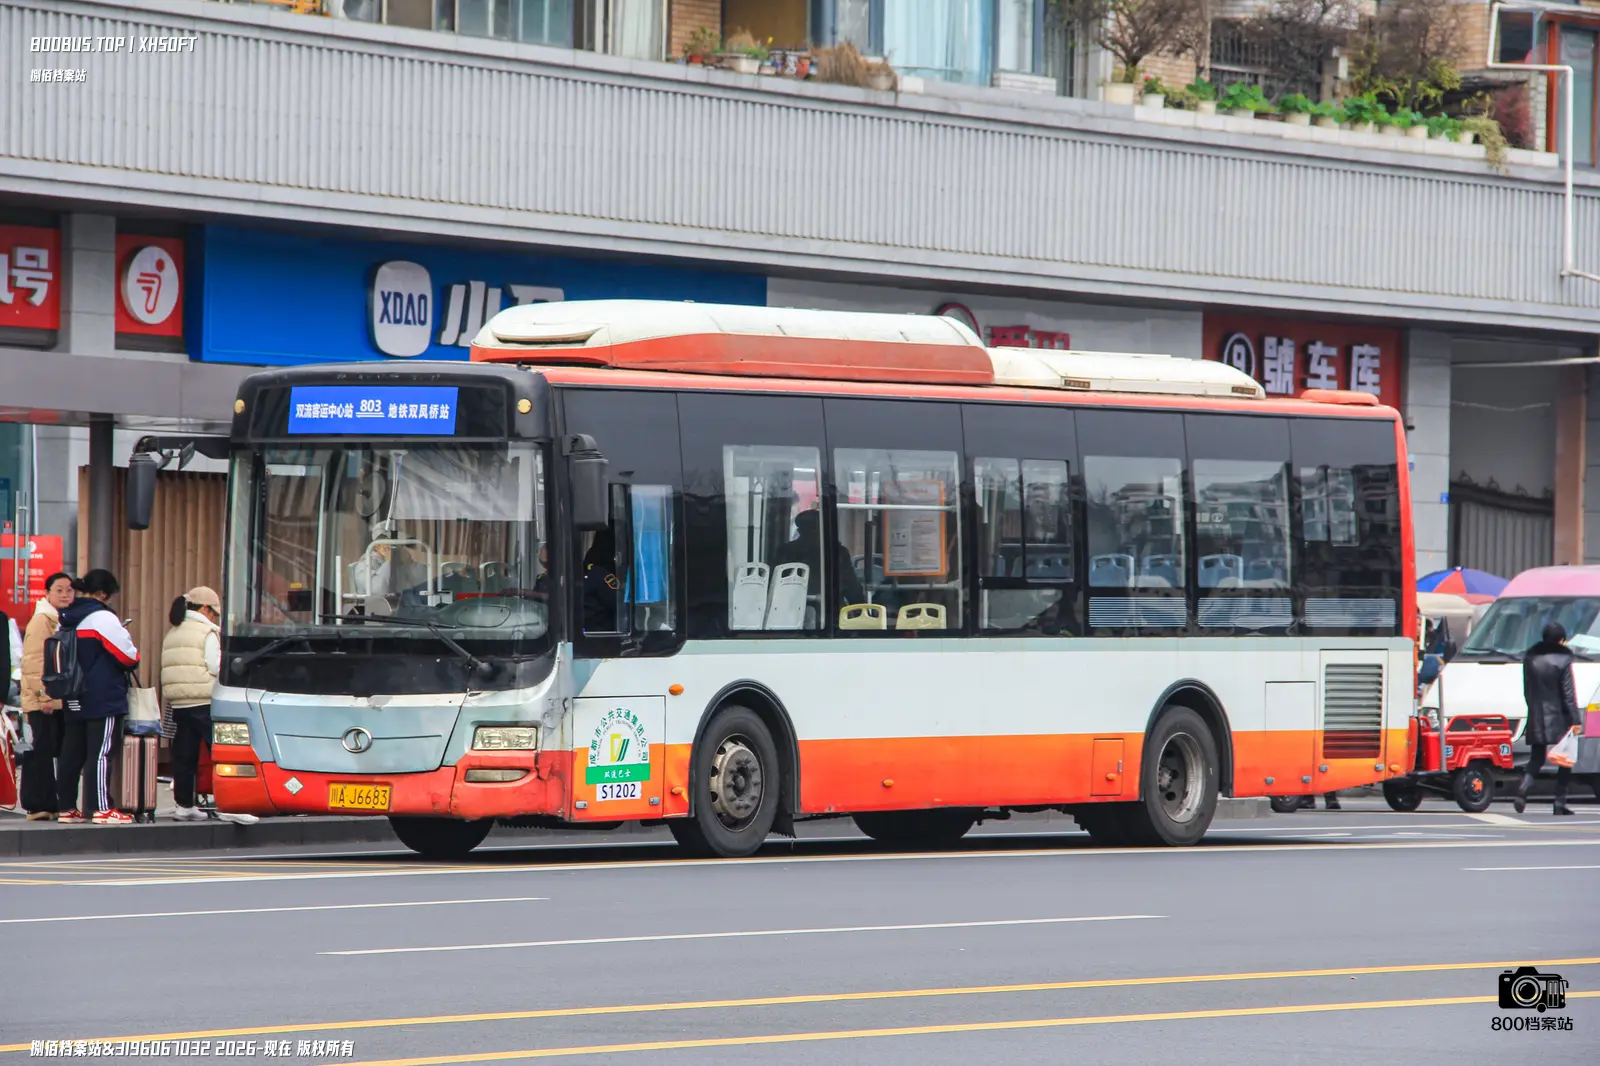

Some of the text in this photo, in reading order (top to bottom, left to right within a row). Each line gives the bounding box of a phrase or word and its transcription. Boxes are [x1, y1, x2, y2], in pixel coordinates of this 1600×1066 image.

[379, 290, 428, 326] XDAO
[295, 399, 450, 420] 双流客运中心站 803 地铁双凤桥站
[601, 783, 636, 799] S1202
